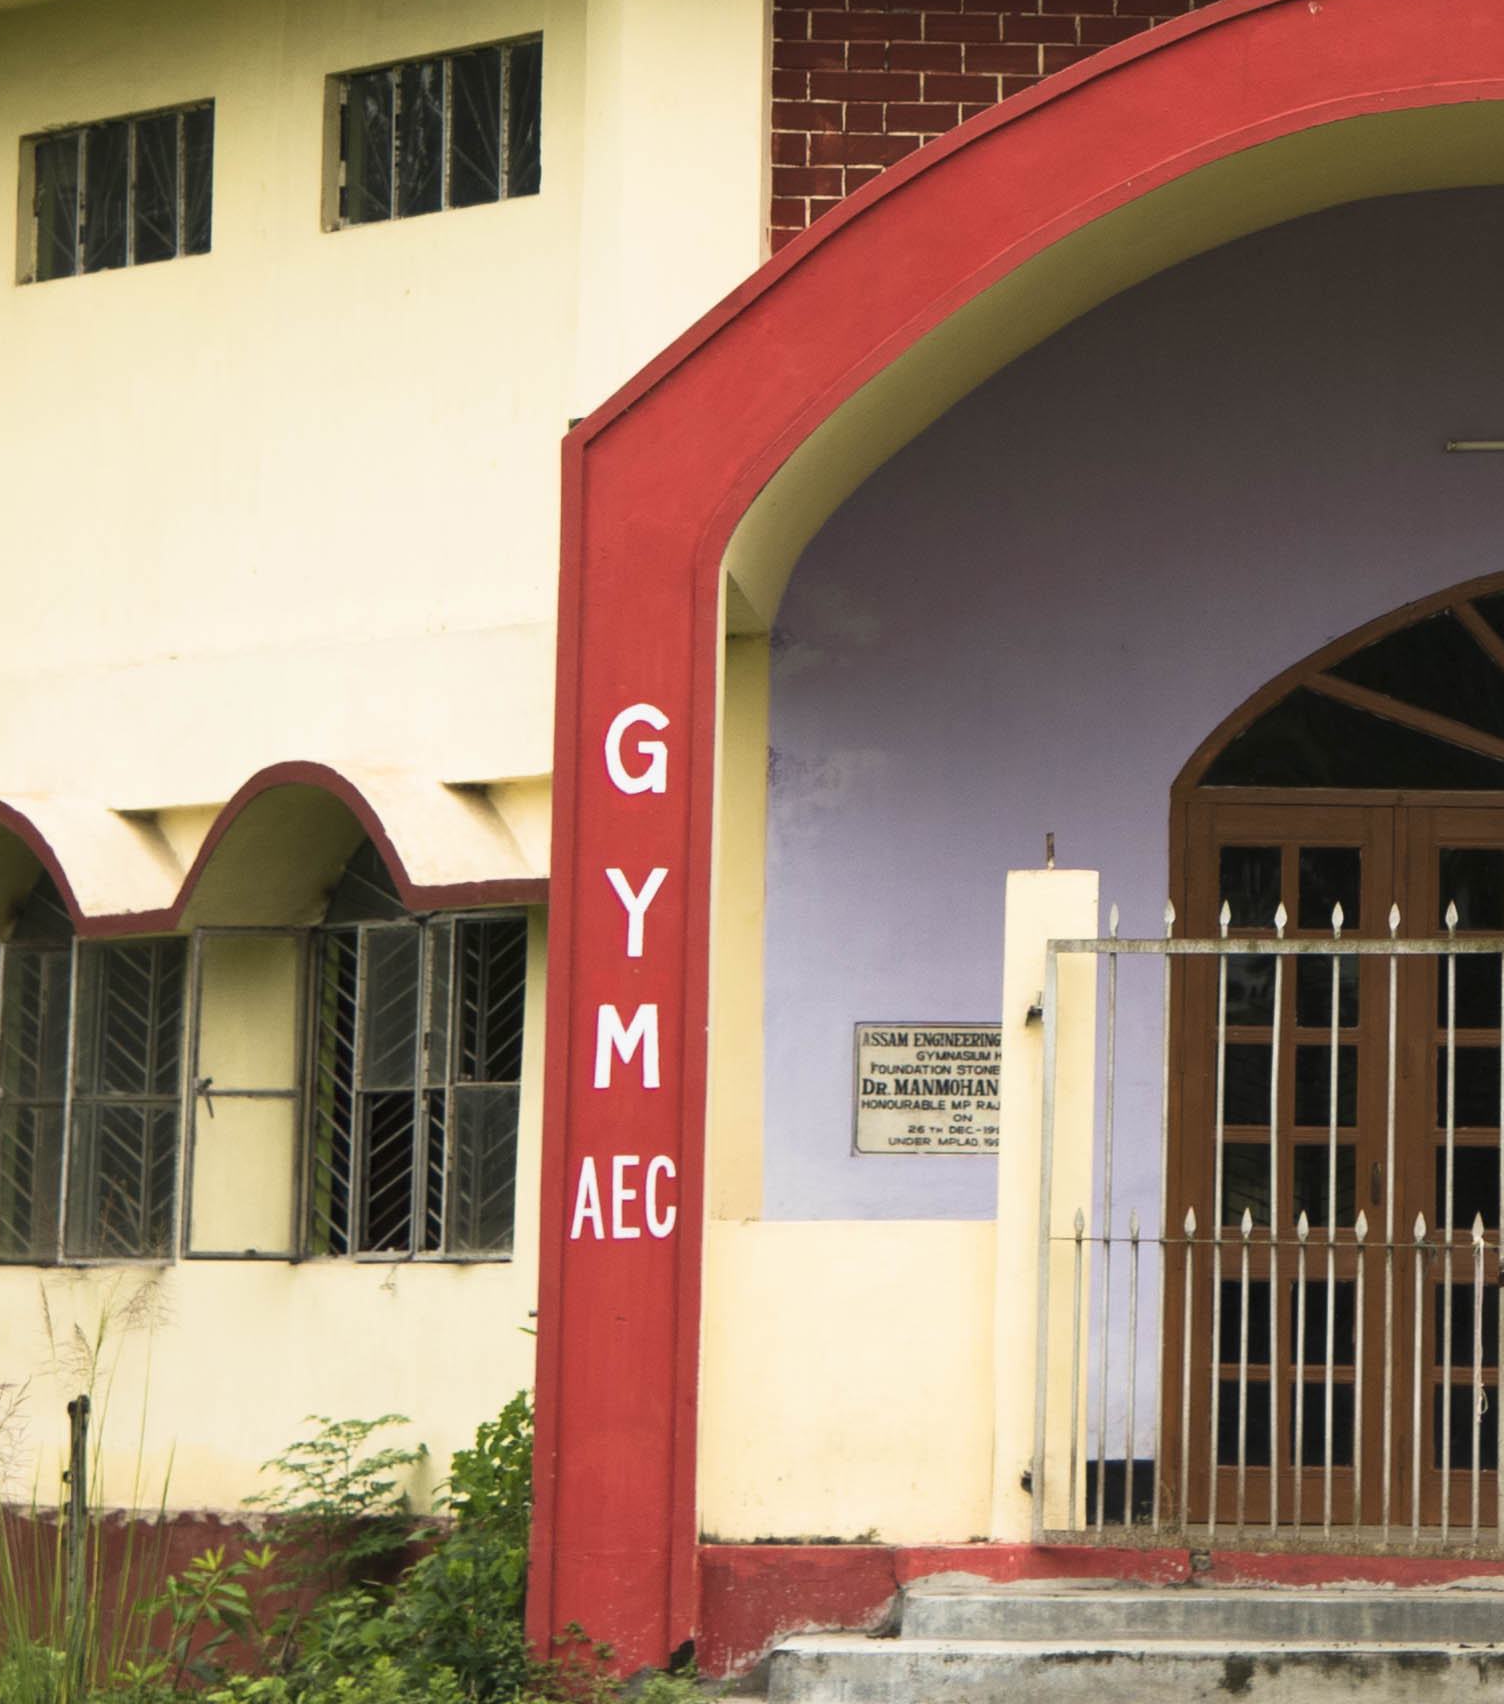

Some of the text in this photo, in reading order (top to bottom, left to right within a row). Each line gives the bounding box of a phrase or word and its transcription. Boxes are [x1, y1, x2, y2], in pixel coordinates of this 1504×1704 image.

[593, 702, 670, 1089] GYM
[862, 1032, 1001, 1047] ASSAM ENGINEERING
[916, 1051, 990, 1061] GYMNASIUM
[870, 1062, 1000, 1075] FOUNDATION STONE
[894, 1079, 999, 1096] MANMOHAN
[862, 1100, 1000, 1111] HONOURABLE MP RAJ
[953, 1114, 972, 1122] ON
[571, 1156, 676, 1239] AEC
